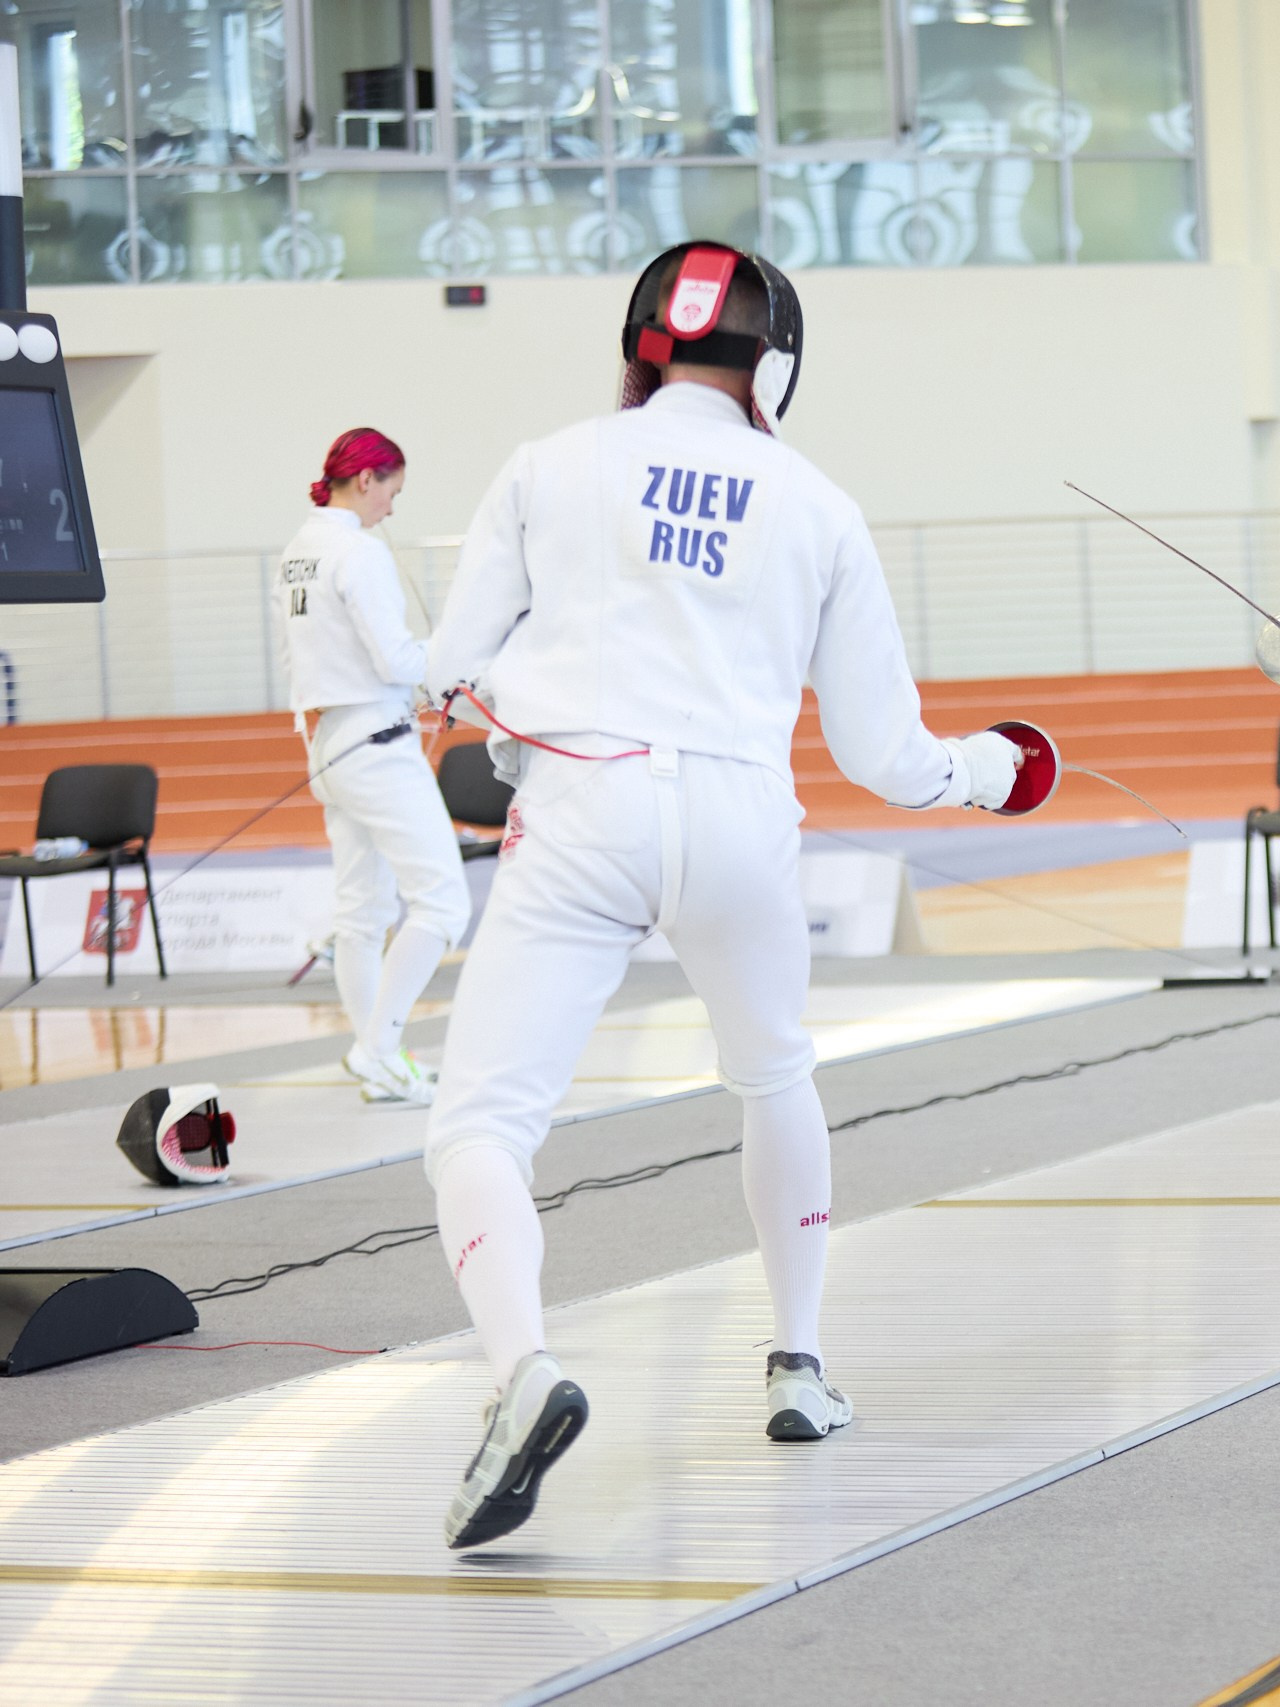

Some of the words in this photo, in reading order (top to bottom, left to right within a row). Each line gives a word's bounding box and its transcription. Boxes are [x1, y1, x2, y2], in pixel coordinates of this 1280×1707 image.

[49, 488, 75, 542] 2
[641, 465, 755, 522] ZUEV
[649, 519, 728, 577] RUS
